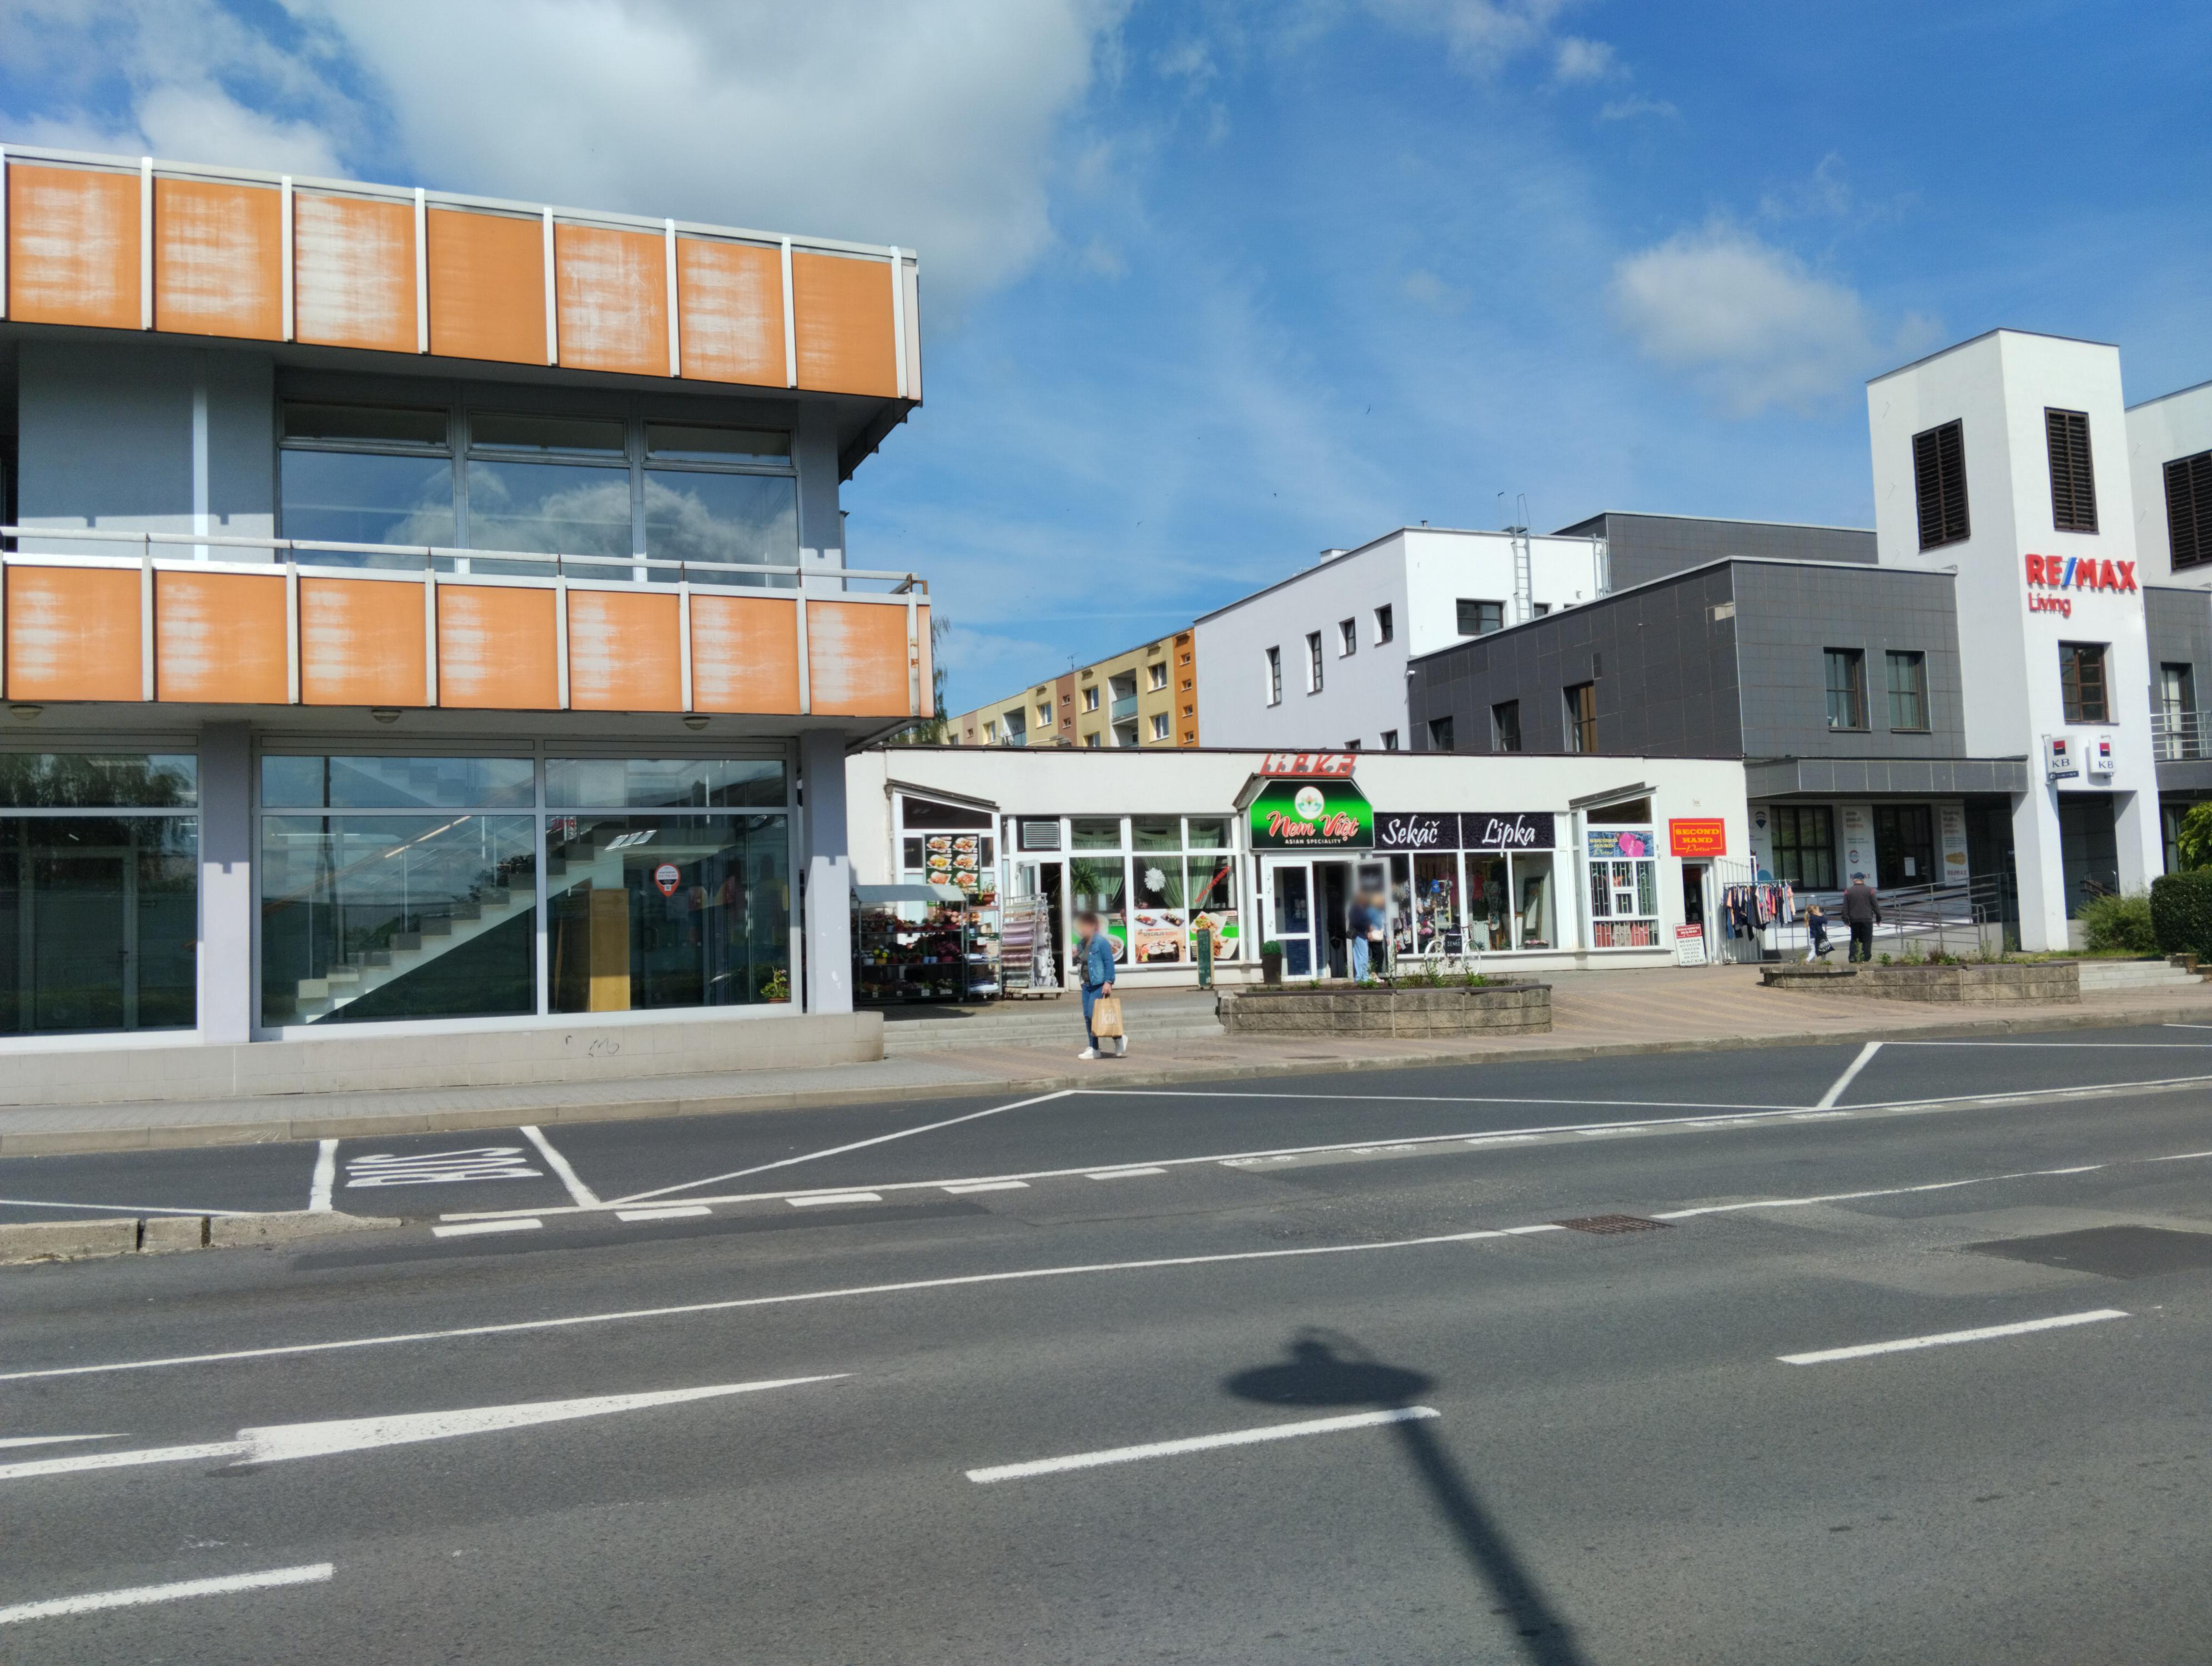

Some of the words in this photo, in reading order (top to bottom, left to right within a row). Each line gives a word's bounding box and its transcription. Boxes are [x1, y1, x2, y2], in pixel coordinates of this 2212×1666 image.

[2025, 554, 2137, 590] RE/MAX
[2028, 592, 2072, 616] Living
[2052, 759, 2070, 768] KB
[1266, 810, 1316, 837] Nem
[1319, 812, 1360, 841] Việt
[1382, 815, 1440, 847] Sekáč
[1482, 814, 1535, 857] Lipka
